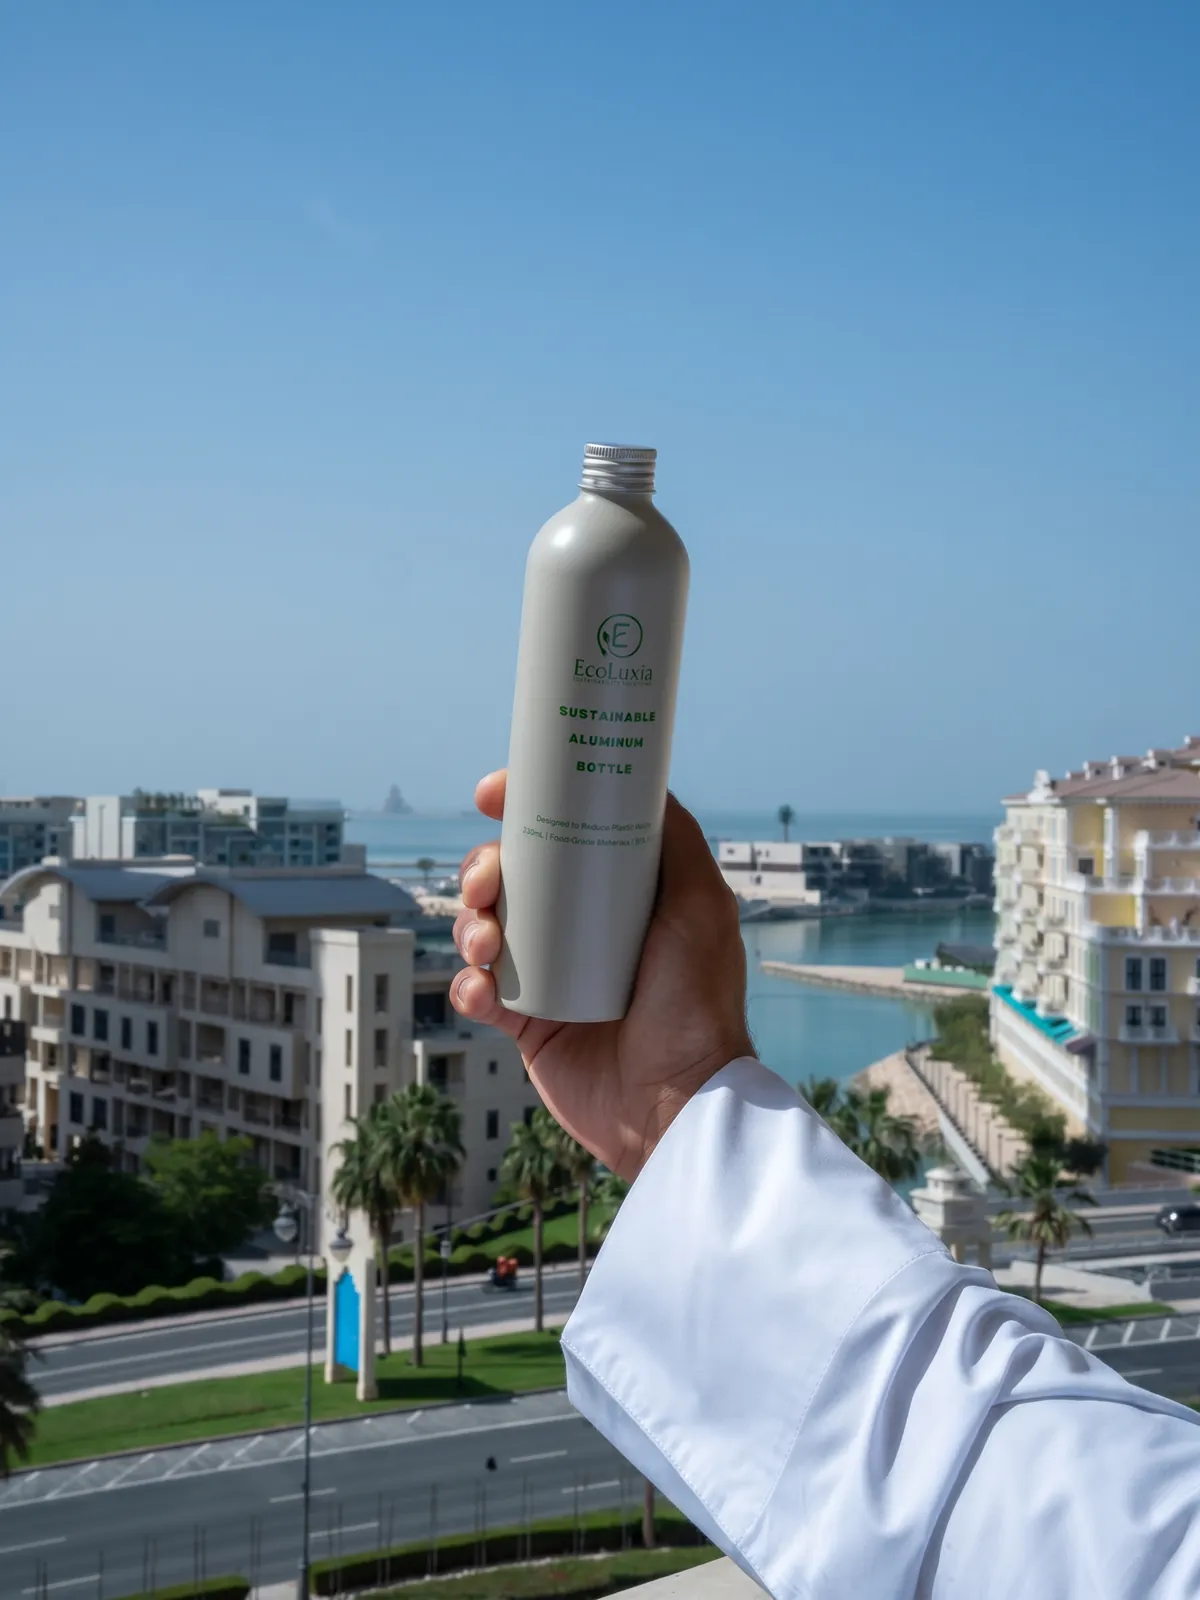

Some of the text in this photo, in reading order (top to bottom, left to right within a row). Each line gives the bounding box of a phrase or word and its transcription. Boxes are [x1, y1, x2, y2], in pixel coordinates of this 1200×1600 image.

[612, 623, 630, 648] E
[574, 658, 653, 681] EcoLuxia
[559, 705, 656, 722] SUSTAINABLE
[568, 733, 644, 748] ALUMINUM
[576, 761, 632, 774] BOTTLE
[536, 814, 570, 827] Designed
[571, 822, 580, 830] to
[581, 822, 610, 831] Reduce
